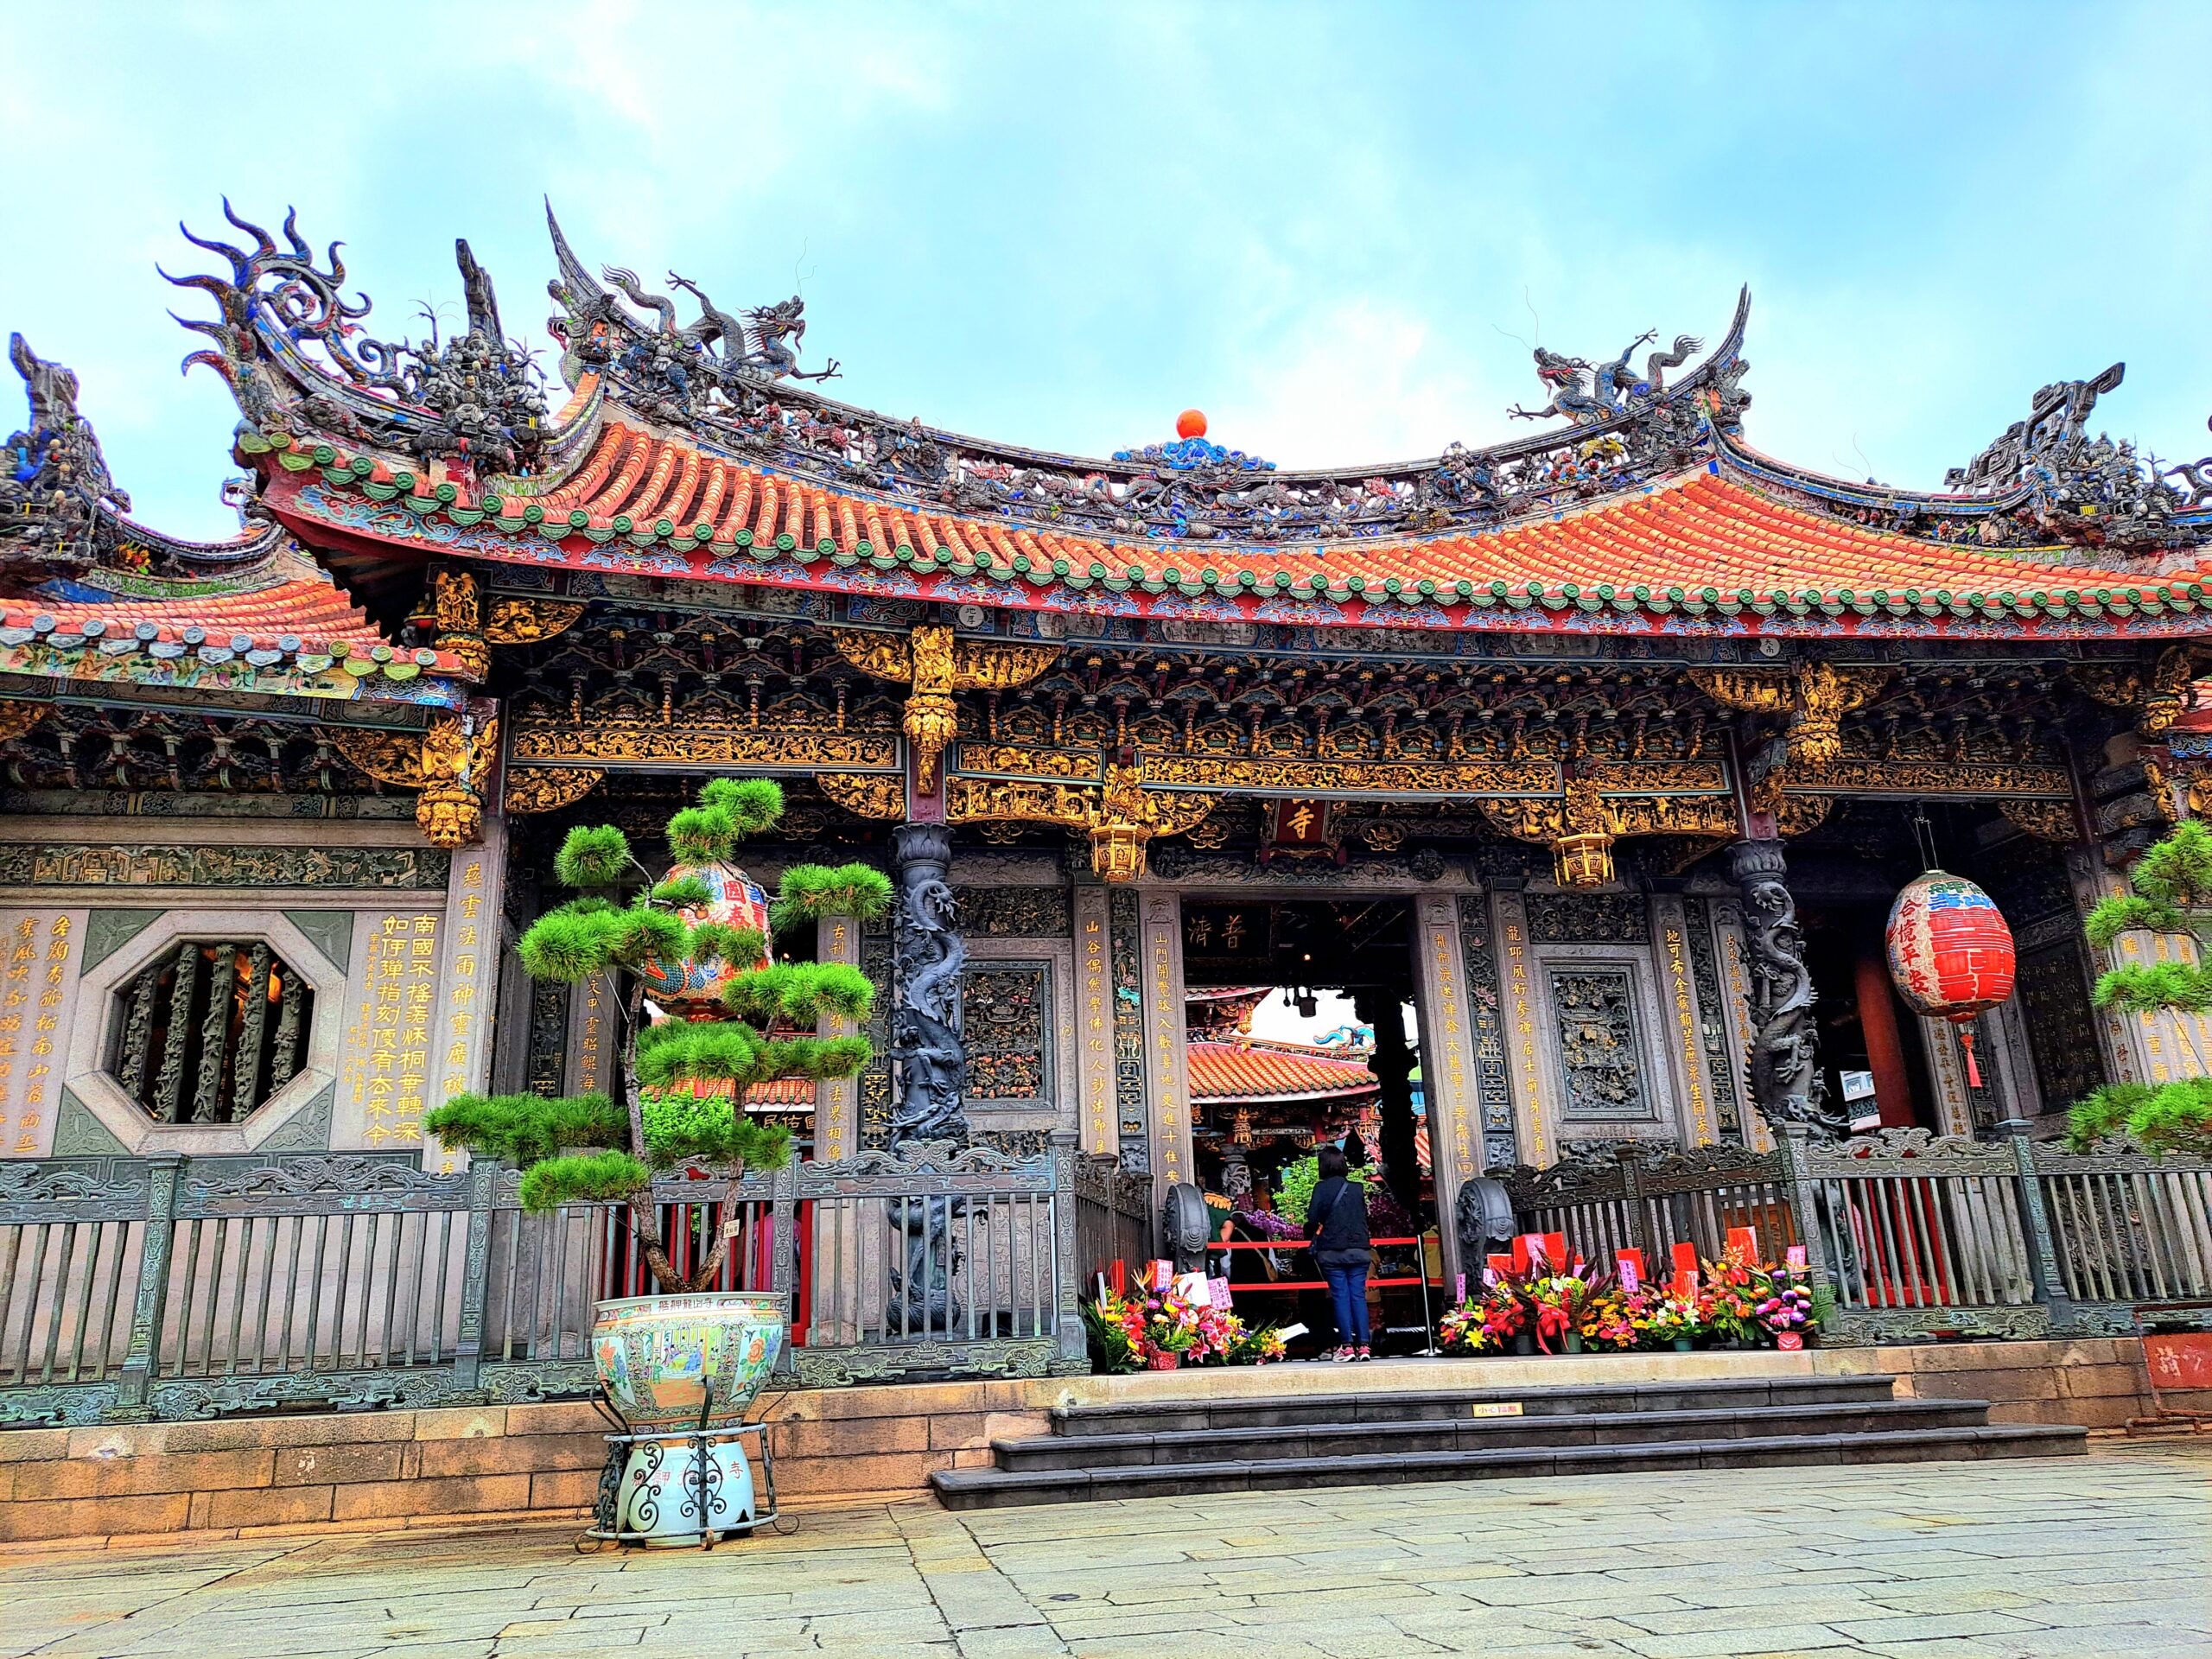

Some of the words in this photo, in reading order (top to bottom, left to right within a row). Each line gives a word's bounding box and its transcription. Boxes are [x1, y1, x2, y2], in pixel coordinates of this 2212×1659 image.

[1287, 798, 1315, 840] 寺
[1898, 899, 1929, 993] 合境平安
